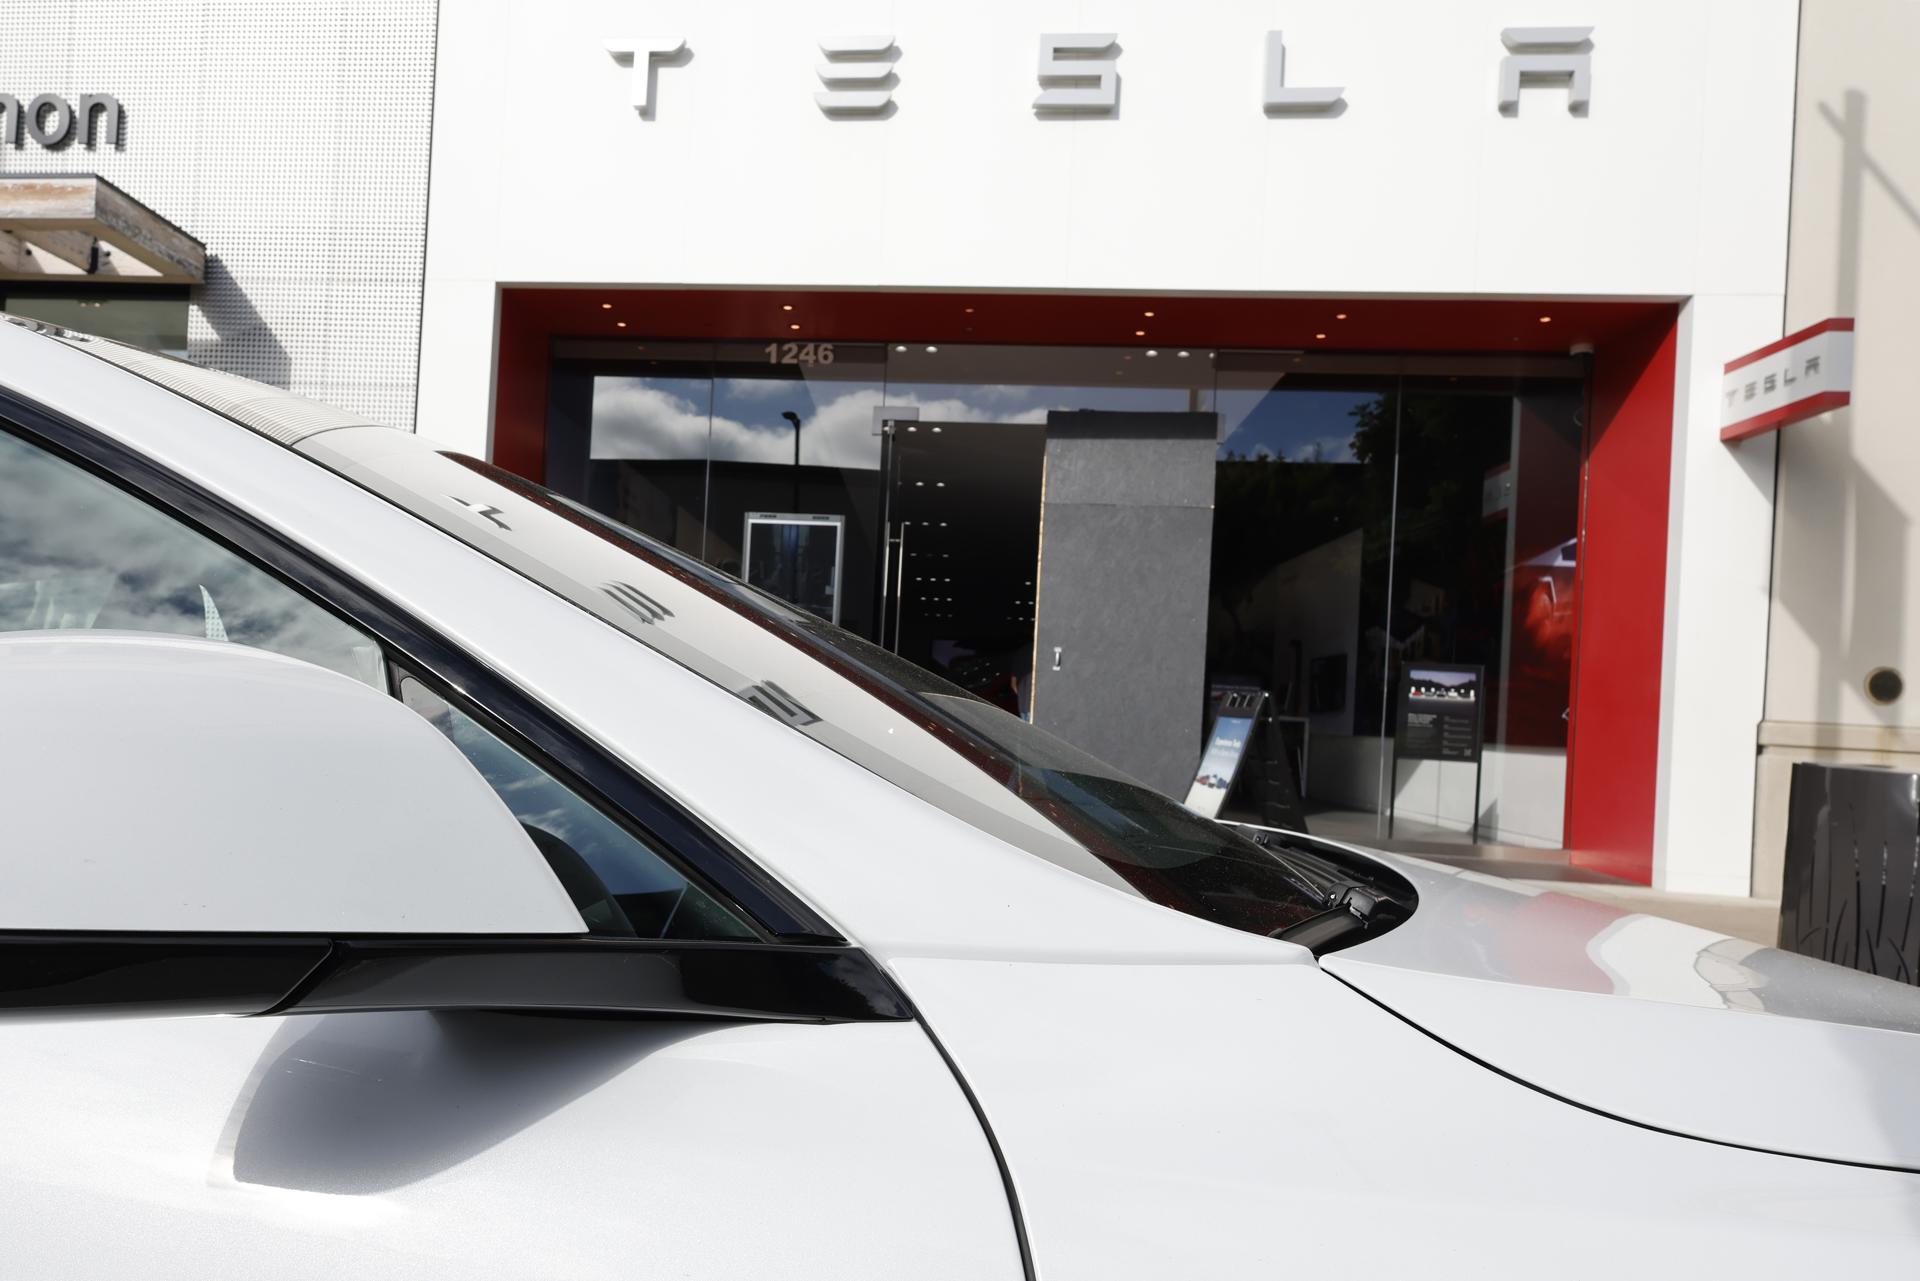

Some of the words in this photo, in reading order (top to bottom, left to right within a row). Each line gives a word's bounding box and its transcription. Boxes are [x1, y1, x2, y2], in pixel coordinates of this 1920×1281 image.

[602, 27, 1594, 118] TESLA
[765, 343, 834, 364] 1246
[1725, 356, 1820, 407] TESLA
